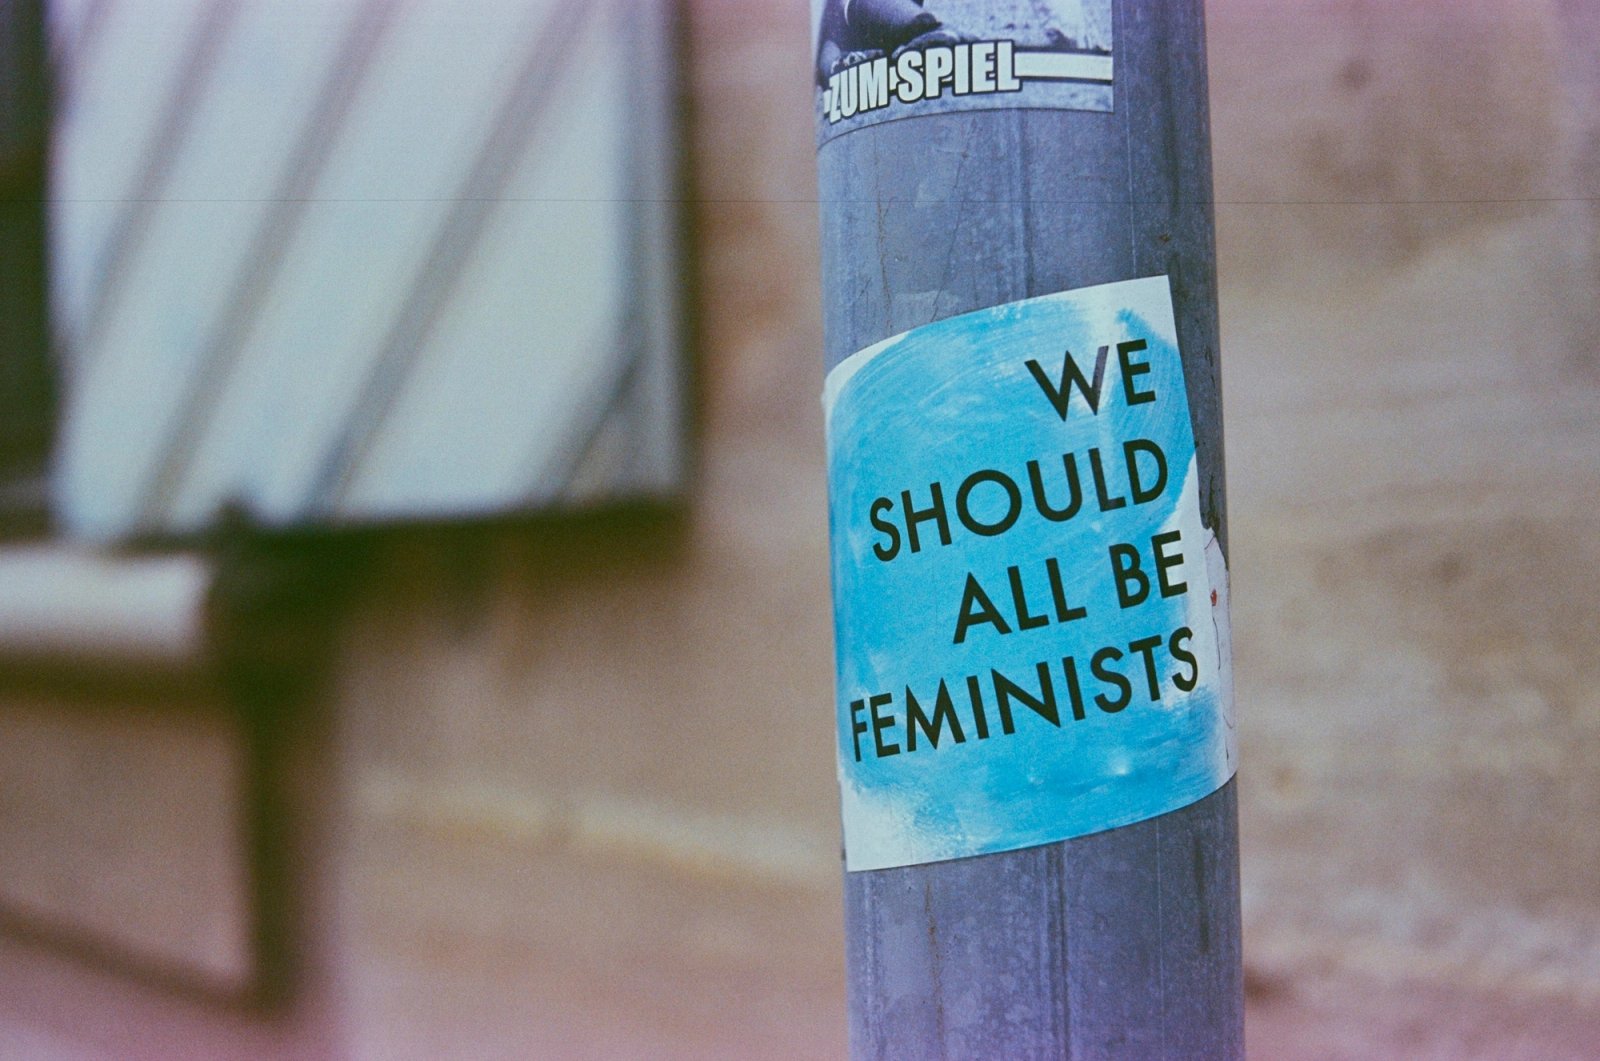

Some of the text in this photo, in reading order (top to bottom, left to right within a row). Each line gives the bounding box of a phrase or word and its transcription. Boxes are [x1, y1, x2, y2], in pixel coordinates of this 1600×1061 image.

[829, 39, 1021, 123] ZUM SPIEL
[1024, 338, 1156, 422] WE
[869, 438, 1168, 562] SHOULD
[953, 530, 1188, 644] ALL BE
[849, 626, 1199, 762] FEMINISTS
